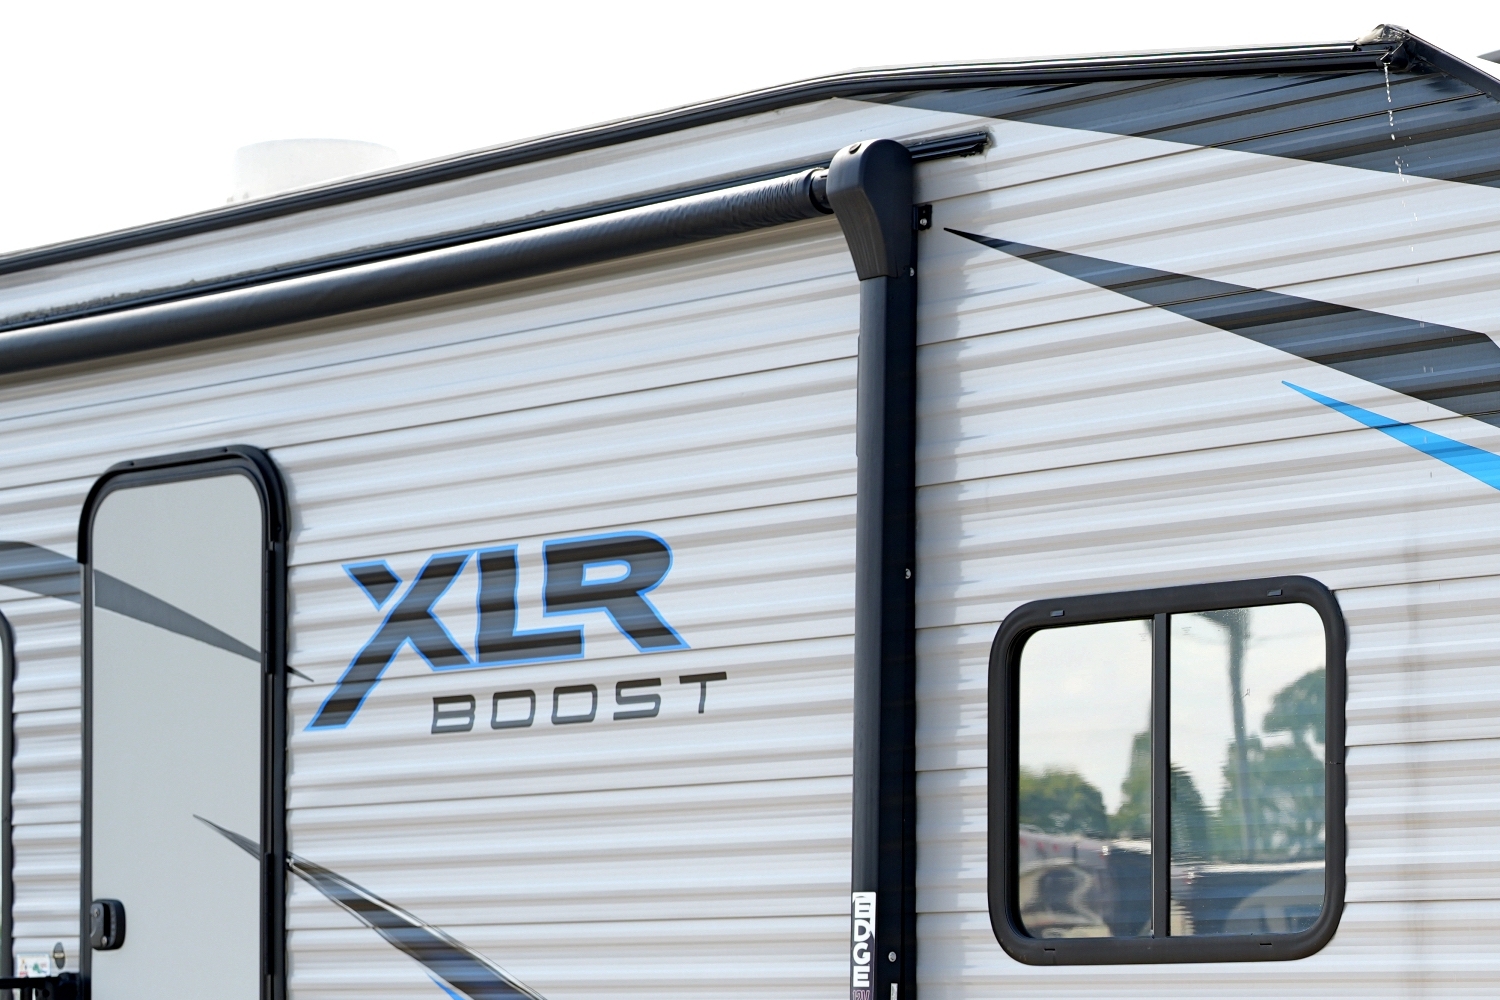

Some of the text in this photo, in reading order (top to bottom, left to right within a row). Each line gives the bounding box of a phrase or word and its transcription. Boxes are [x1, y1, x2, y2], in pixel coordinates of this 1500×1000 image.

[303, 530, 692, 732] XLR
[431, 671, 728, 735] BOOST
[853, 896, 871, 988] EDGE
